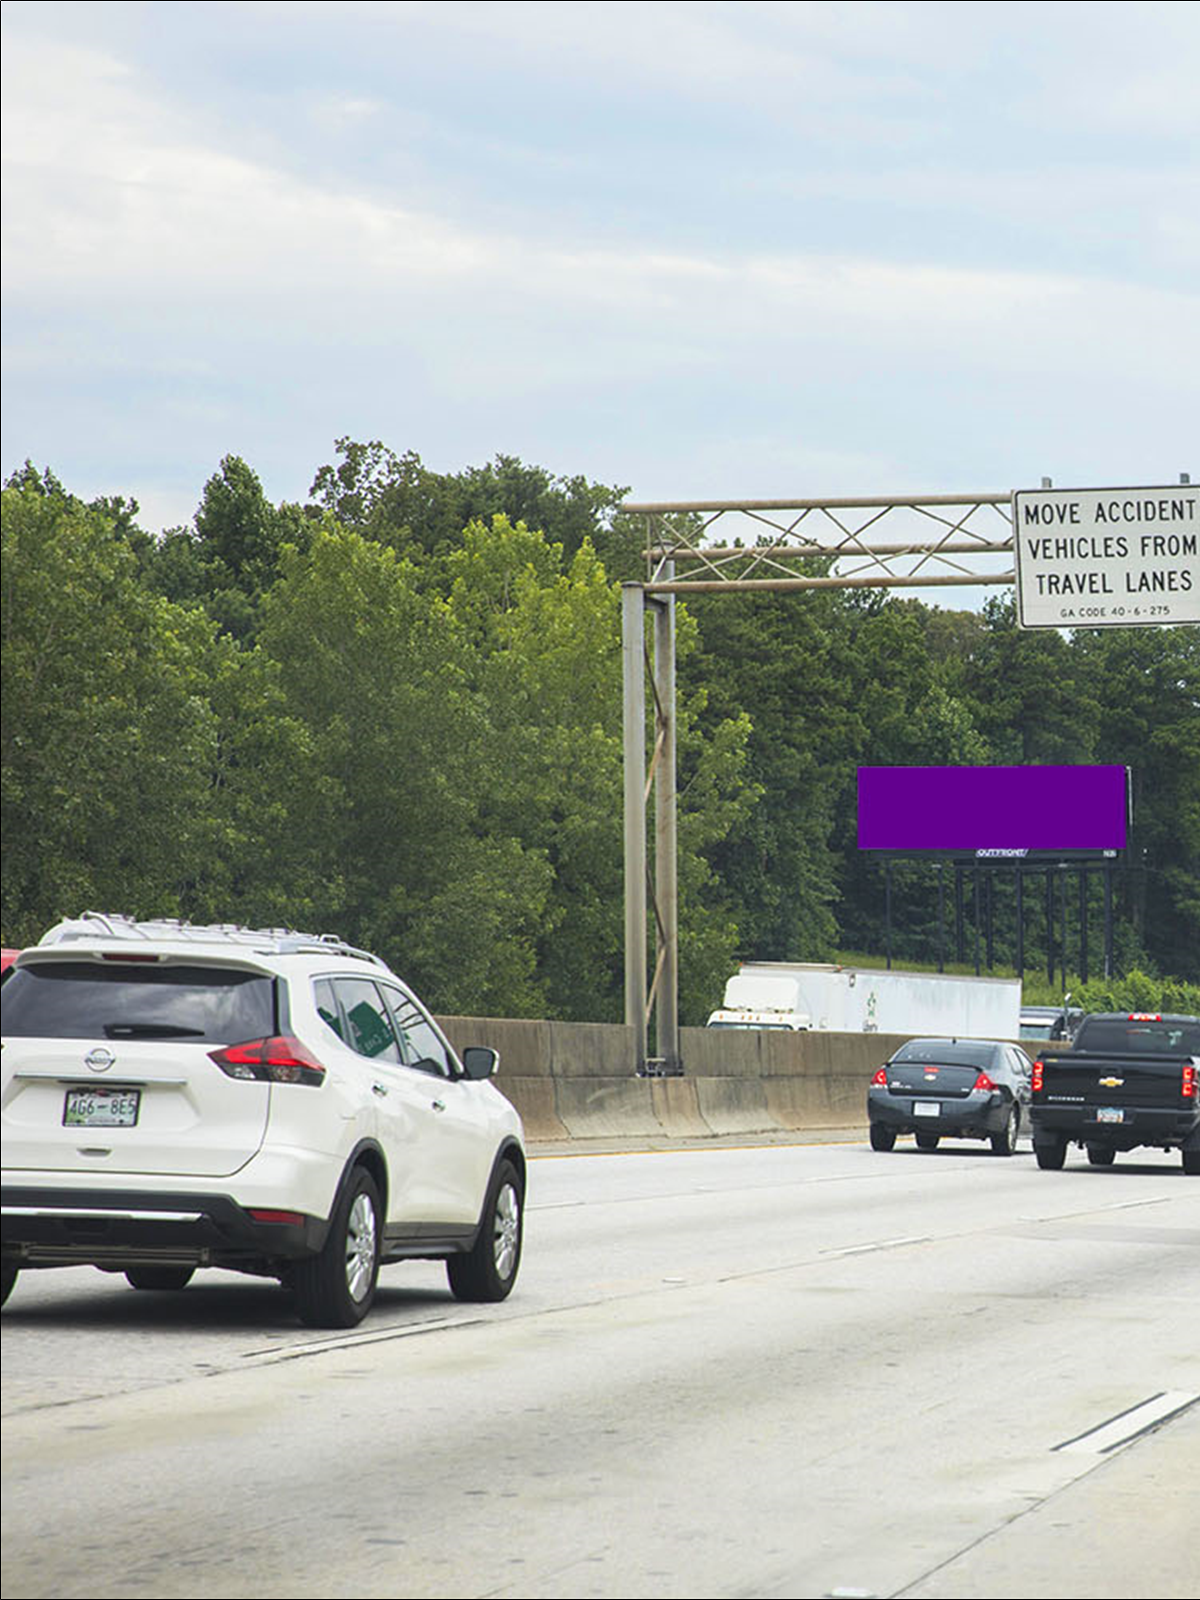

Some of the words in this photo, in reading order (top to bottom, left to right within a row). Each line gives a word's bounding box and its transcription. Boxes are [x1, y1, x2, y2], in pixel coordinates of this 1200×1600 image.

[1025, 503, 1081, 525] MOVE
[1095, 500, 1196, 523] ACCIDENT
[1028, 537, 1128, 560] VEHICLES
[1141, 534, 1197, 557] FROM
[1036, 573, 1114, 595] TRAVEL
[1126, 570, 1193, 593] LANES
[1060, 608, 1075, 618] GA
[1079, 607, 1106, 617] CODE
